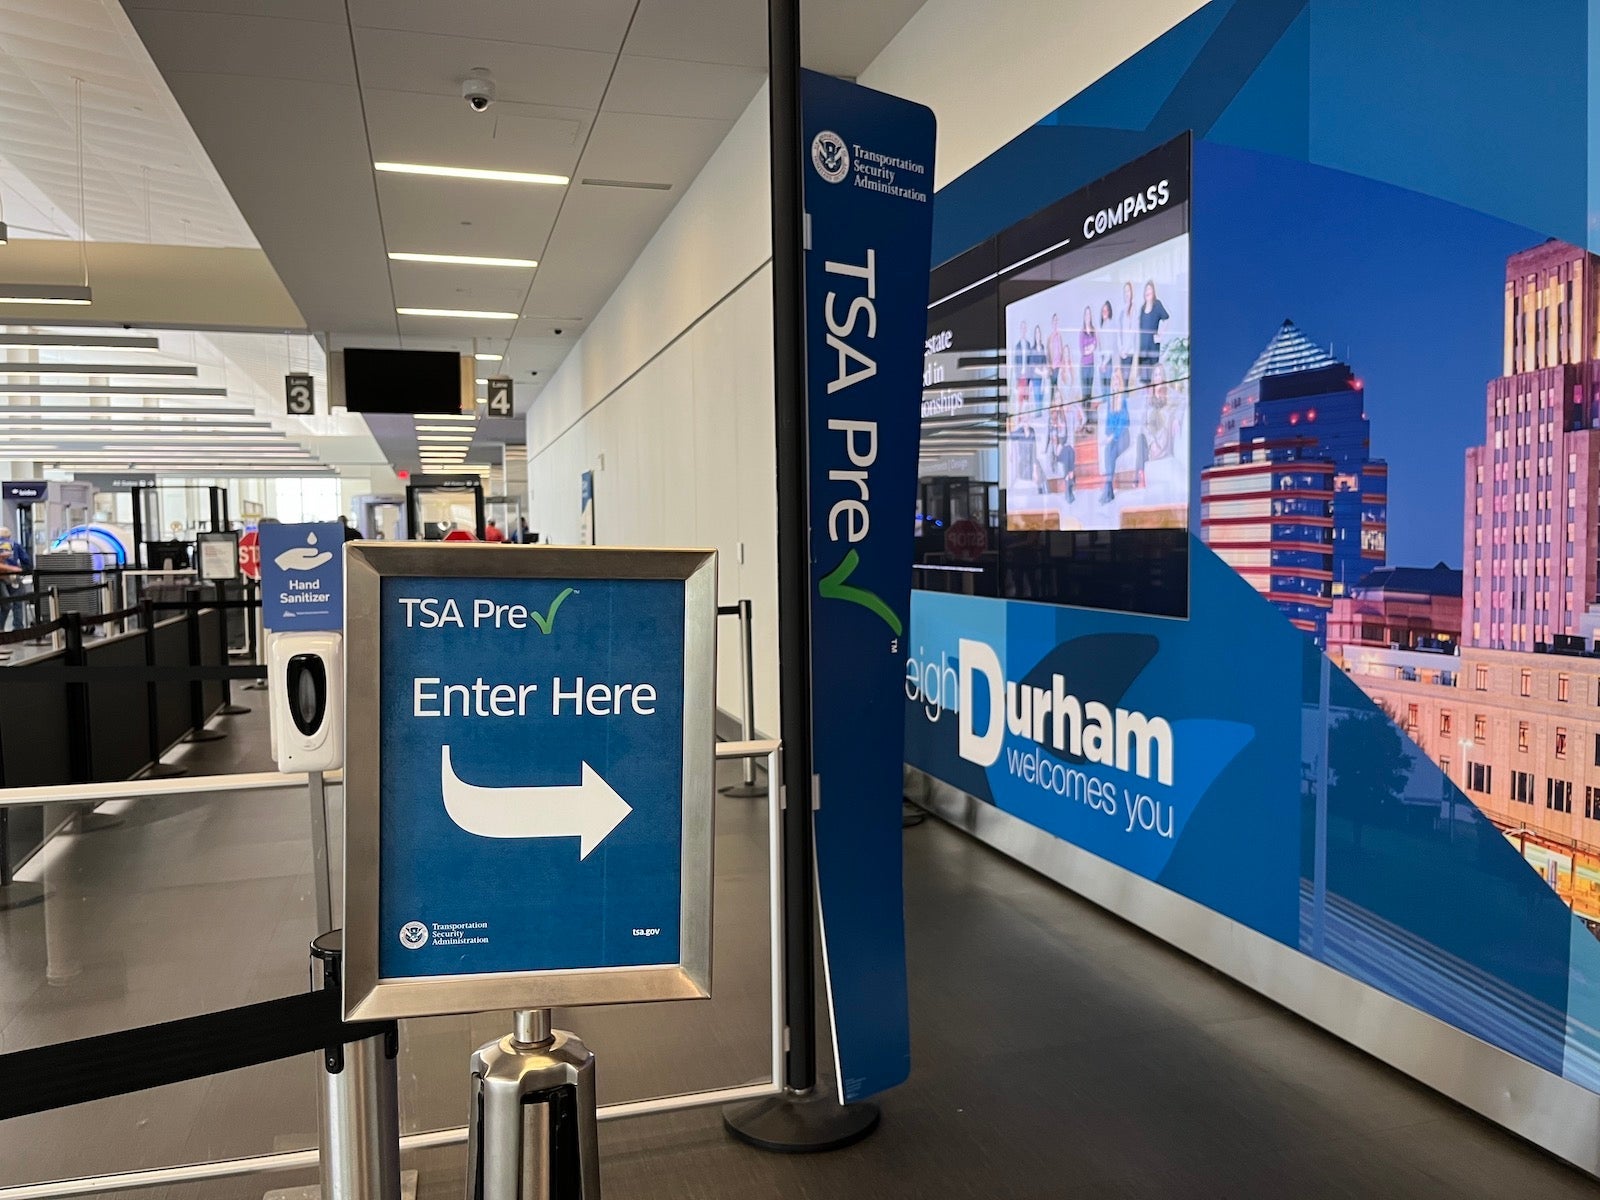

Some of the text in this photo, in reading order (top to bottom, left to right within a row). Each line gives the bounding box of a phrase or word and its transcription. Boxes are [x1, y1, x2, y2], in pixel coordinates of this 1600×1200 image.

[853, 144, 925, 174] Transportation
[853, 160, 896, 185] Security
[854, 174, 927, 203] Administration
[1083, 179, 1170, 240] COMPASS
[824, 249, 877, 395] TSA
[925, 329, 953, 357] state
[933, 361, 944, 384] in
[290, 386, 310, 413] 3
[491, 389, 511, 414] 4
[827, 418, 878, 543] Pre
[239, 545, 260, 564] ST
[280, 592, 330, 604] Sanitizer
[289, 579, 320, 590] Hand
[399, 598, 464, 628] TSA
[473, 599, 527, 629] Pre
[413, 676, 657, 717] Enter Here
[959, 637, 1174, 787] Durham
[1006, 746, 1174, 839] welcomes you
[432, 922, 488, 931] Transportation
[432, 930, 465, 939] Security
[632, 928, 660, 937] tsa.gov
[432, 936, 489, 946] Administration
